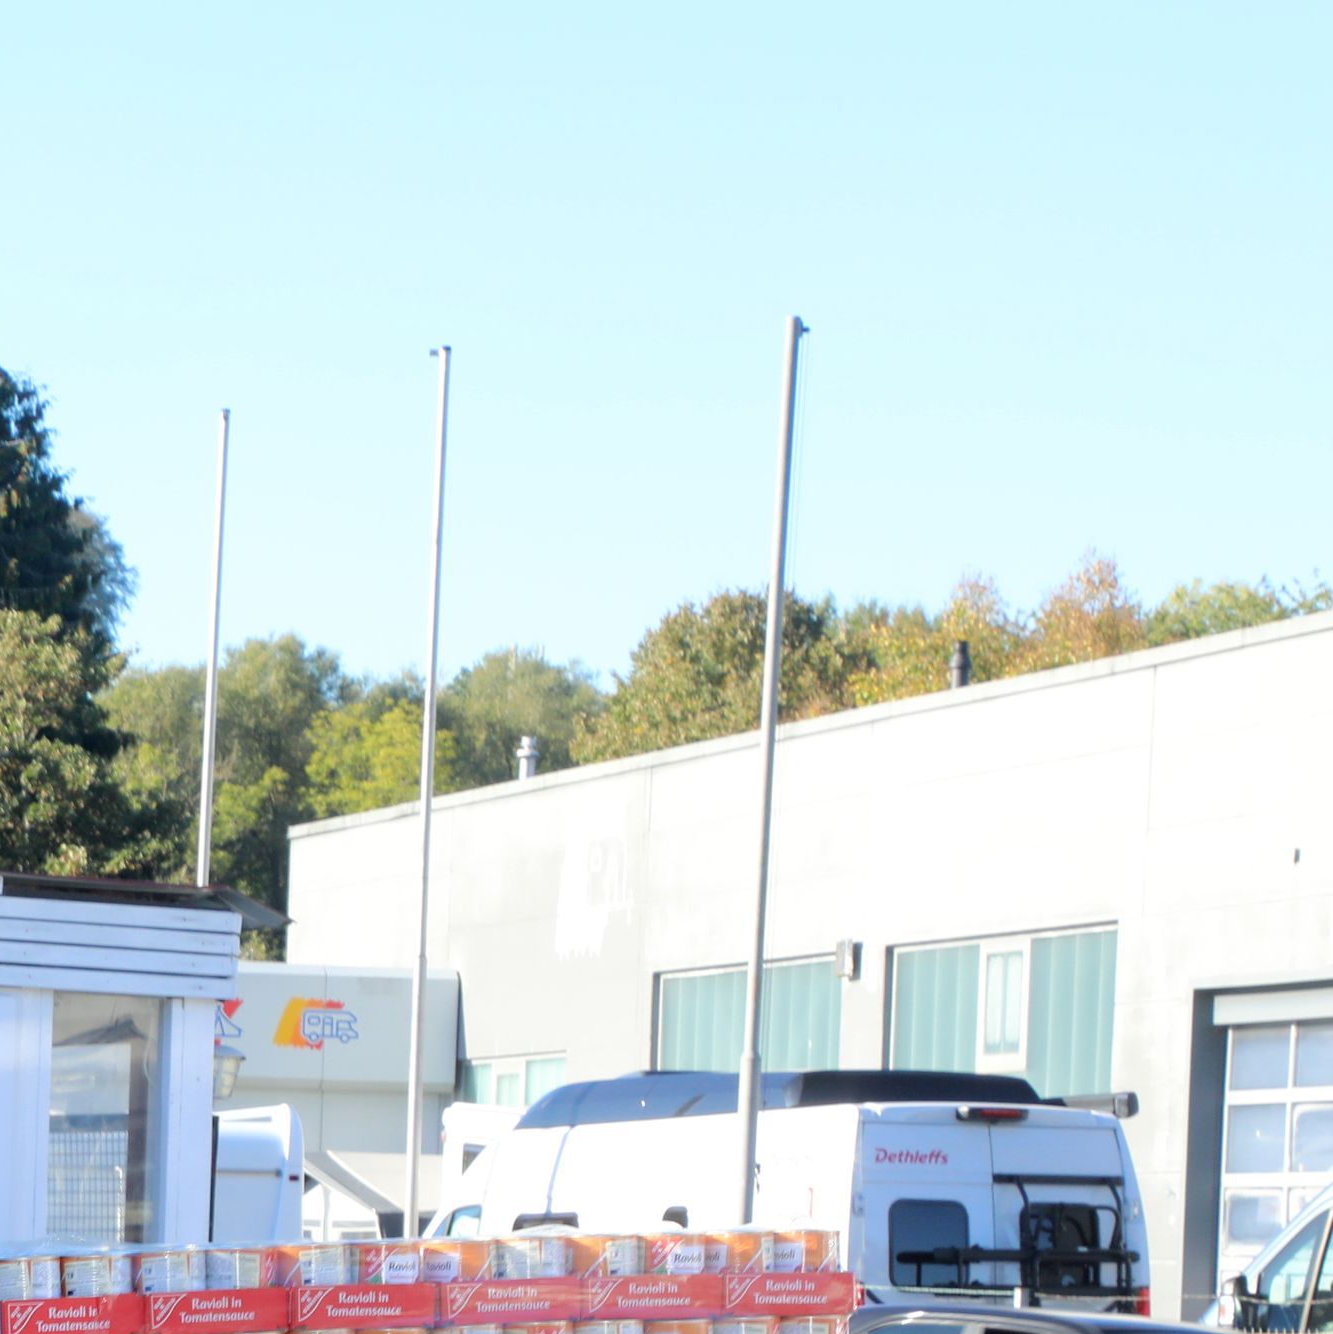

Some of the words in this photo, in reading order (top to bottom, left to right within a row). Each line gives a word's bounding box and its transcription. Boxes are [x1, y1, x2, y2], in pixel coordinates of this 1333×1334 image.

[874, 1147, 949, 1165] Dethleffs
[487, 1285, 525, 1299] Ravioli
[527, 1285, 538, 1298] in
[629, 1281, 665, 1295] Ravioli
[667, 1281, 678, 1293] in
[766, 1278, 802, 1292] Ravioli
[805, 1278, 815, 1290] in
[191, 1296, 229, 1310] Ravioli
[231, 1296, 242, 1309] in
[338, 1290, 376, 1304] Ravioli
[379, 1290, 389, 1303] in
[616, 1295, 691, 1309] Tomatensauce
[753, 1292, 828, 1306] Tomatensauce
[48, 1305, 86, 1320] Ravioli
[326, 1304, 402, 1318] Tomatensauce
[476, 1299, 551, 1313] Tomatensauce
[179, 1310, 256, 1324] Tomatensauce
